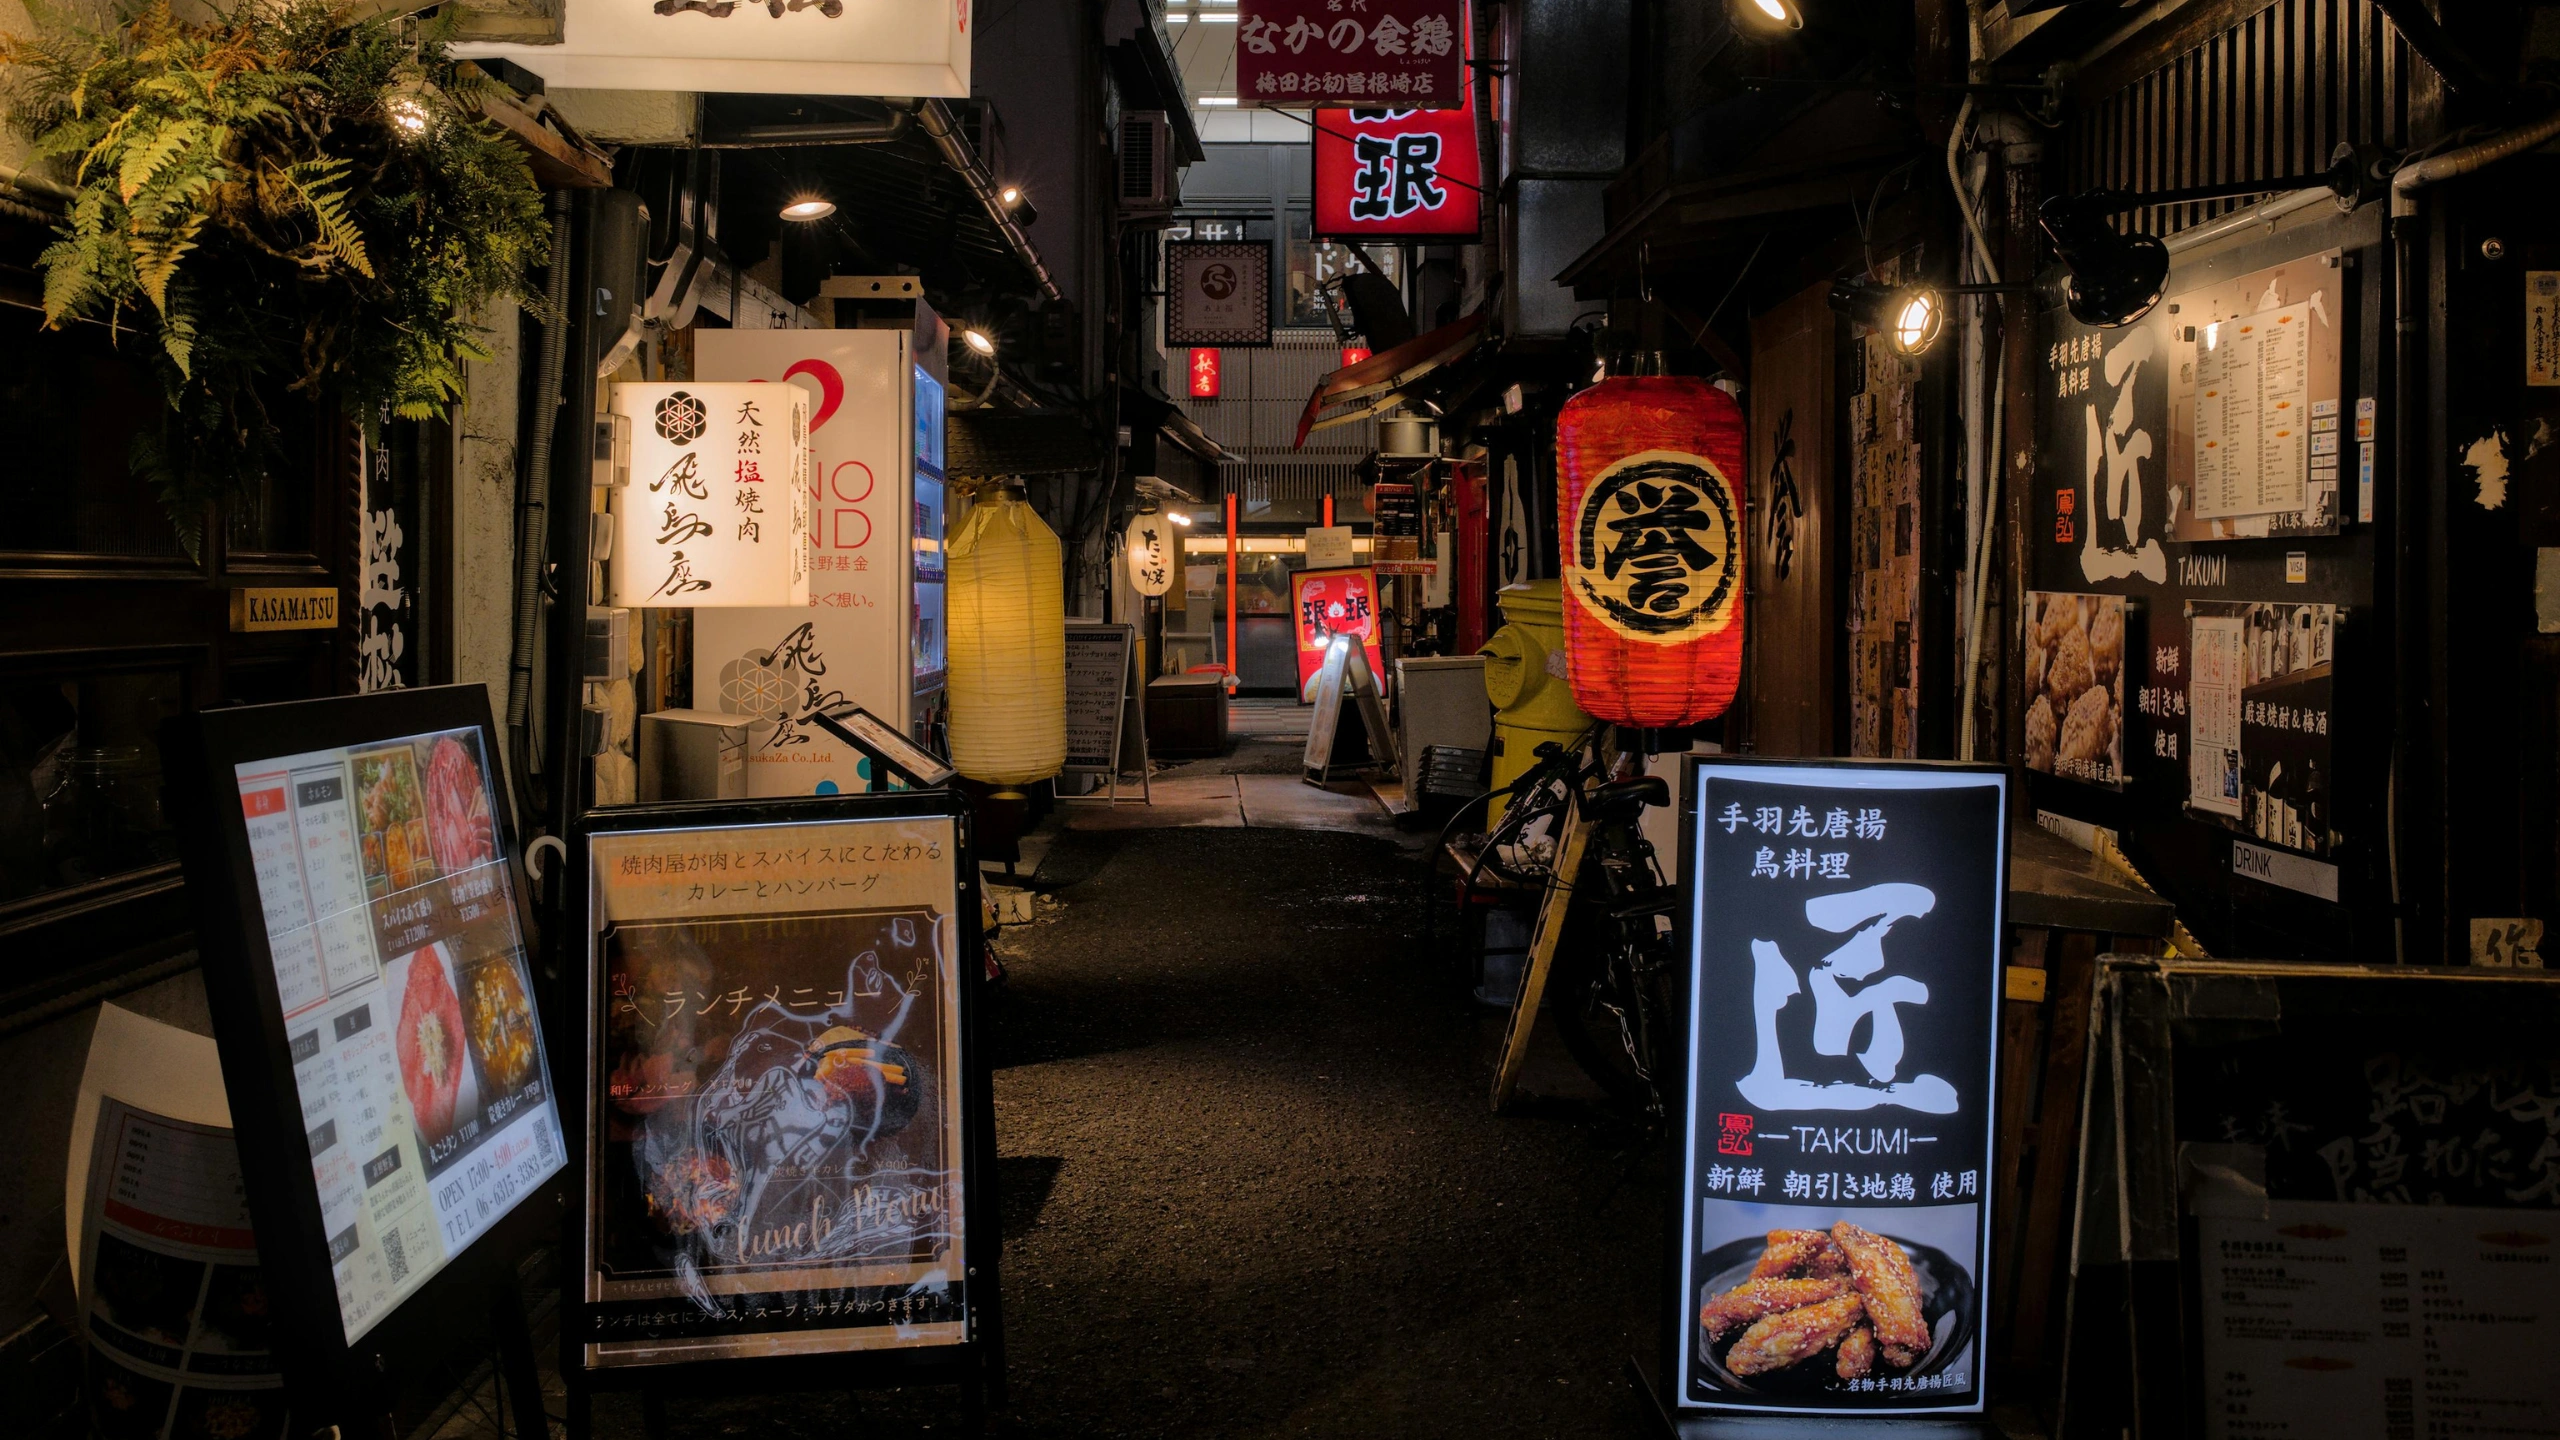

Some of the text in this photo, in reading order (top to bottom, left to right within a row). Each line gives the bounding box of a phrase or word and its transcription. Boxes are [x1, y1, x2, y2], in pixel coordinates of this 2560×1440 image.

[1240, 14, 1454, 57] なかの食鶏
[2048, 332, 2103, 371] 手羽先唐揚
[2058, 366, 2091, 399] 鳥料理
[733, 400, 764, 544] 天然塩焼肉
[2080, 325, 2168, 585] 匠
[1140, 529, 1166, 587] たこ焼
[2177, 554, 2227, 587] TAKUMI
[2289, 561, 2305, 575] VISA
[249, 596, 335, 622] KASAMATSU
[2155, 645, 2180, 677] 新鮮
[2154, 728, 2179, 761] 使用
[1718, 802, 1888, 840] 手羽先唐揚
[2037, 811, 2061, 837] FOOD
[620, 840, 942, 877] 焼肉屋が肉とスパイスにこだわる
[1751, 846, 1851, 880] 鳥料理
[2234, 853, 2272, 879] DRINK
[687, 873, 880, 901] カレーとハンバーグ
[663, 984, 882, 1020] ランチメニュー
[1735, 882, 1960, 1114] 匠
[610, 1080, 693, 1097] 和牛ハンバーグ
[437, 1175, 464, 1214] OPEN
[1707, 1163, 1979, 1201] 新鮮 朝引き地鶏 使用
[1847, 1373, 1967, 1393] 名物手羽先唐揚匠風
